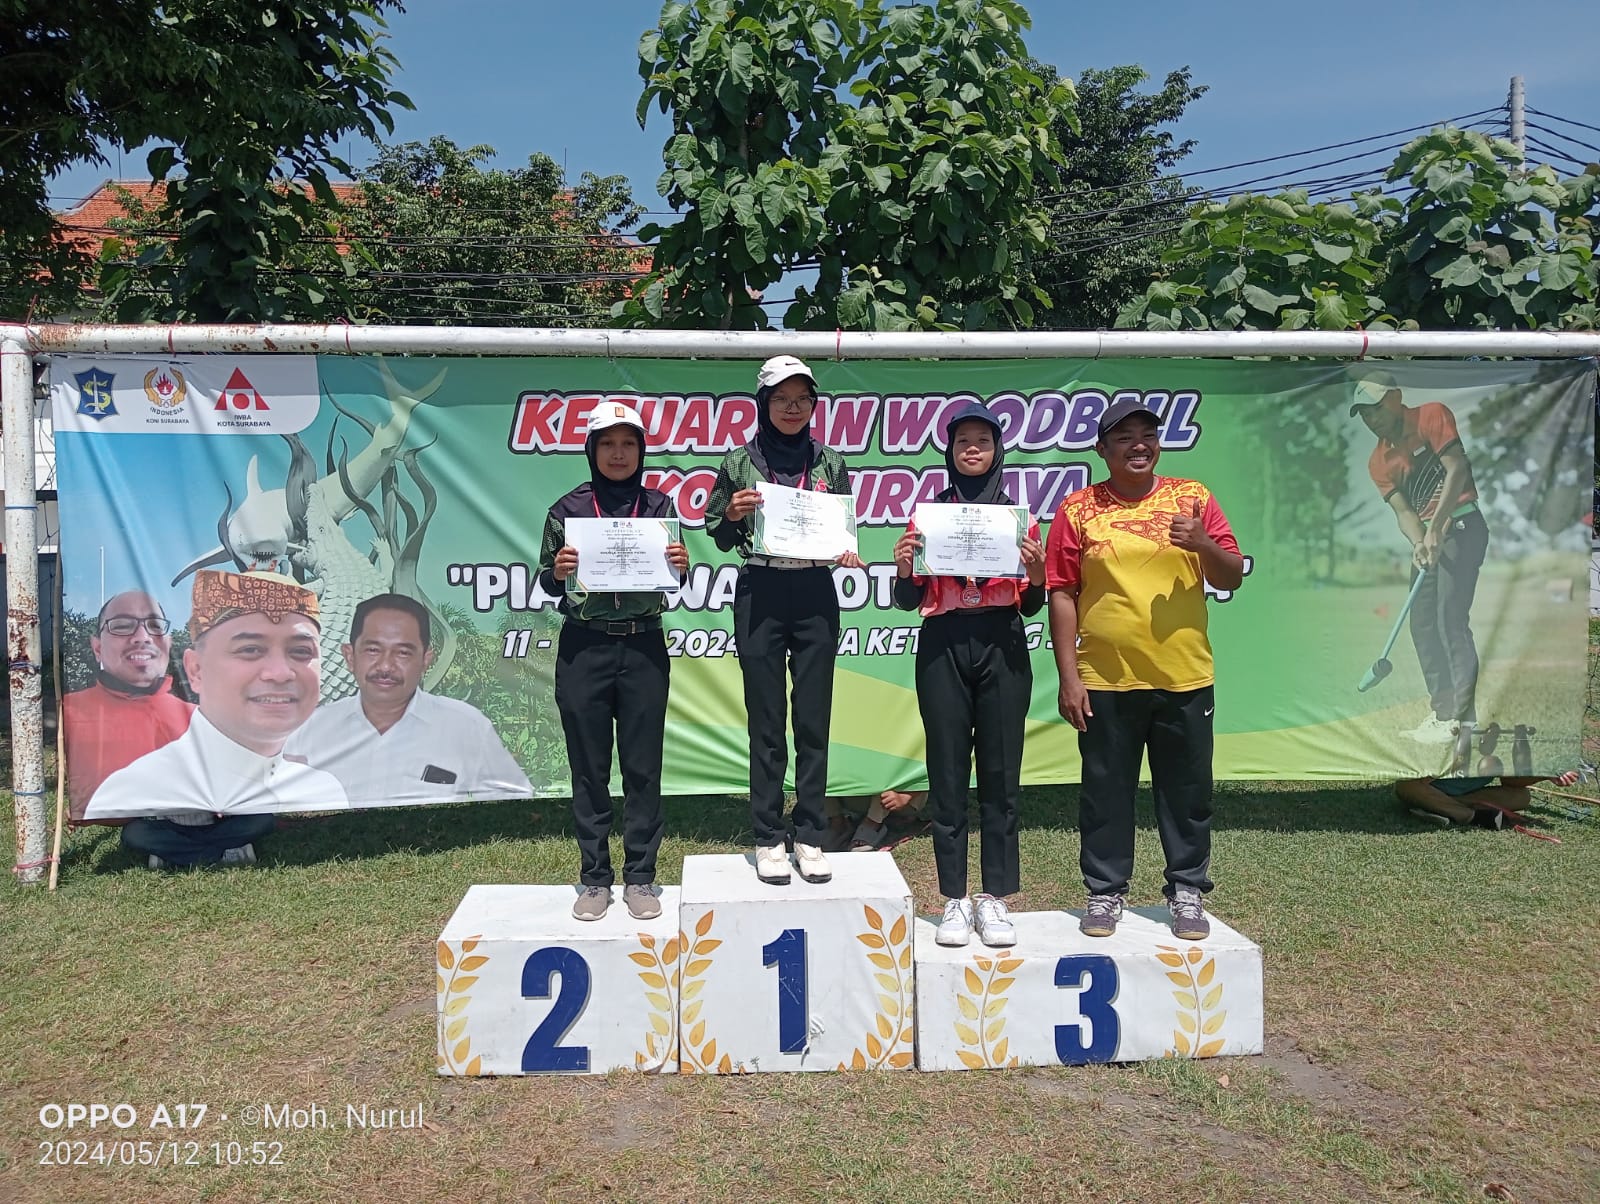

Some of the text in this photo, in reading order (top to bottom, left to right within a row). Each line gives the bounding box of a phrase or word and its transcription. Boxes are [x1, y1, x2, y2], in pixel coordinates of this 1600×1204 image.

[150, 406, 184, 416] INDONESIA
[512, 392, 1198, 452] KEUARAN WODBL
[503, 630, 530, 658] 11
[521, 946, 591, 1074] 2
[762, 928, 810, 1055] 1
[1053, 954, 1120, 1066] 3
